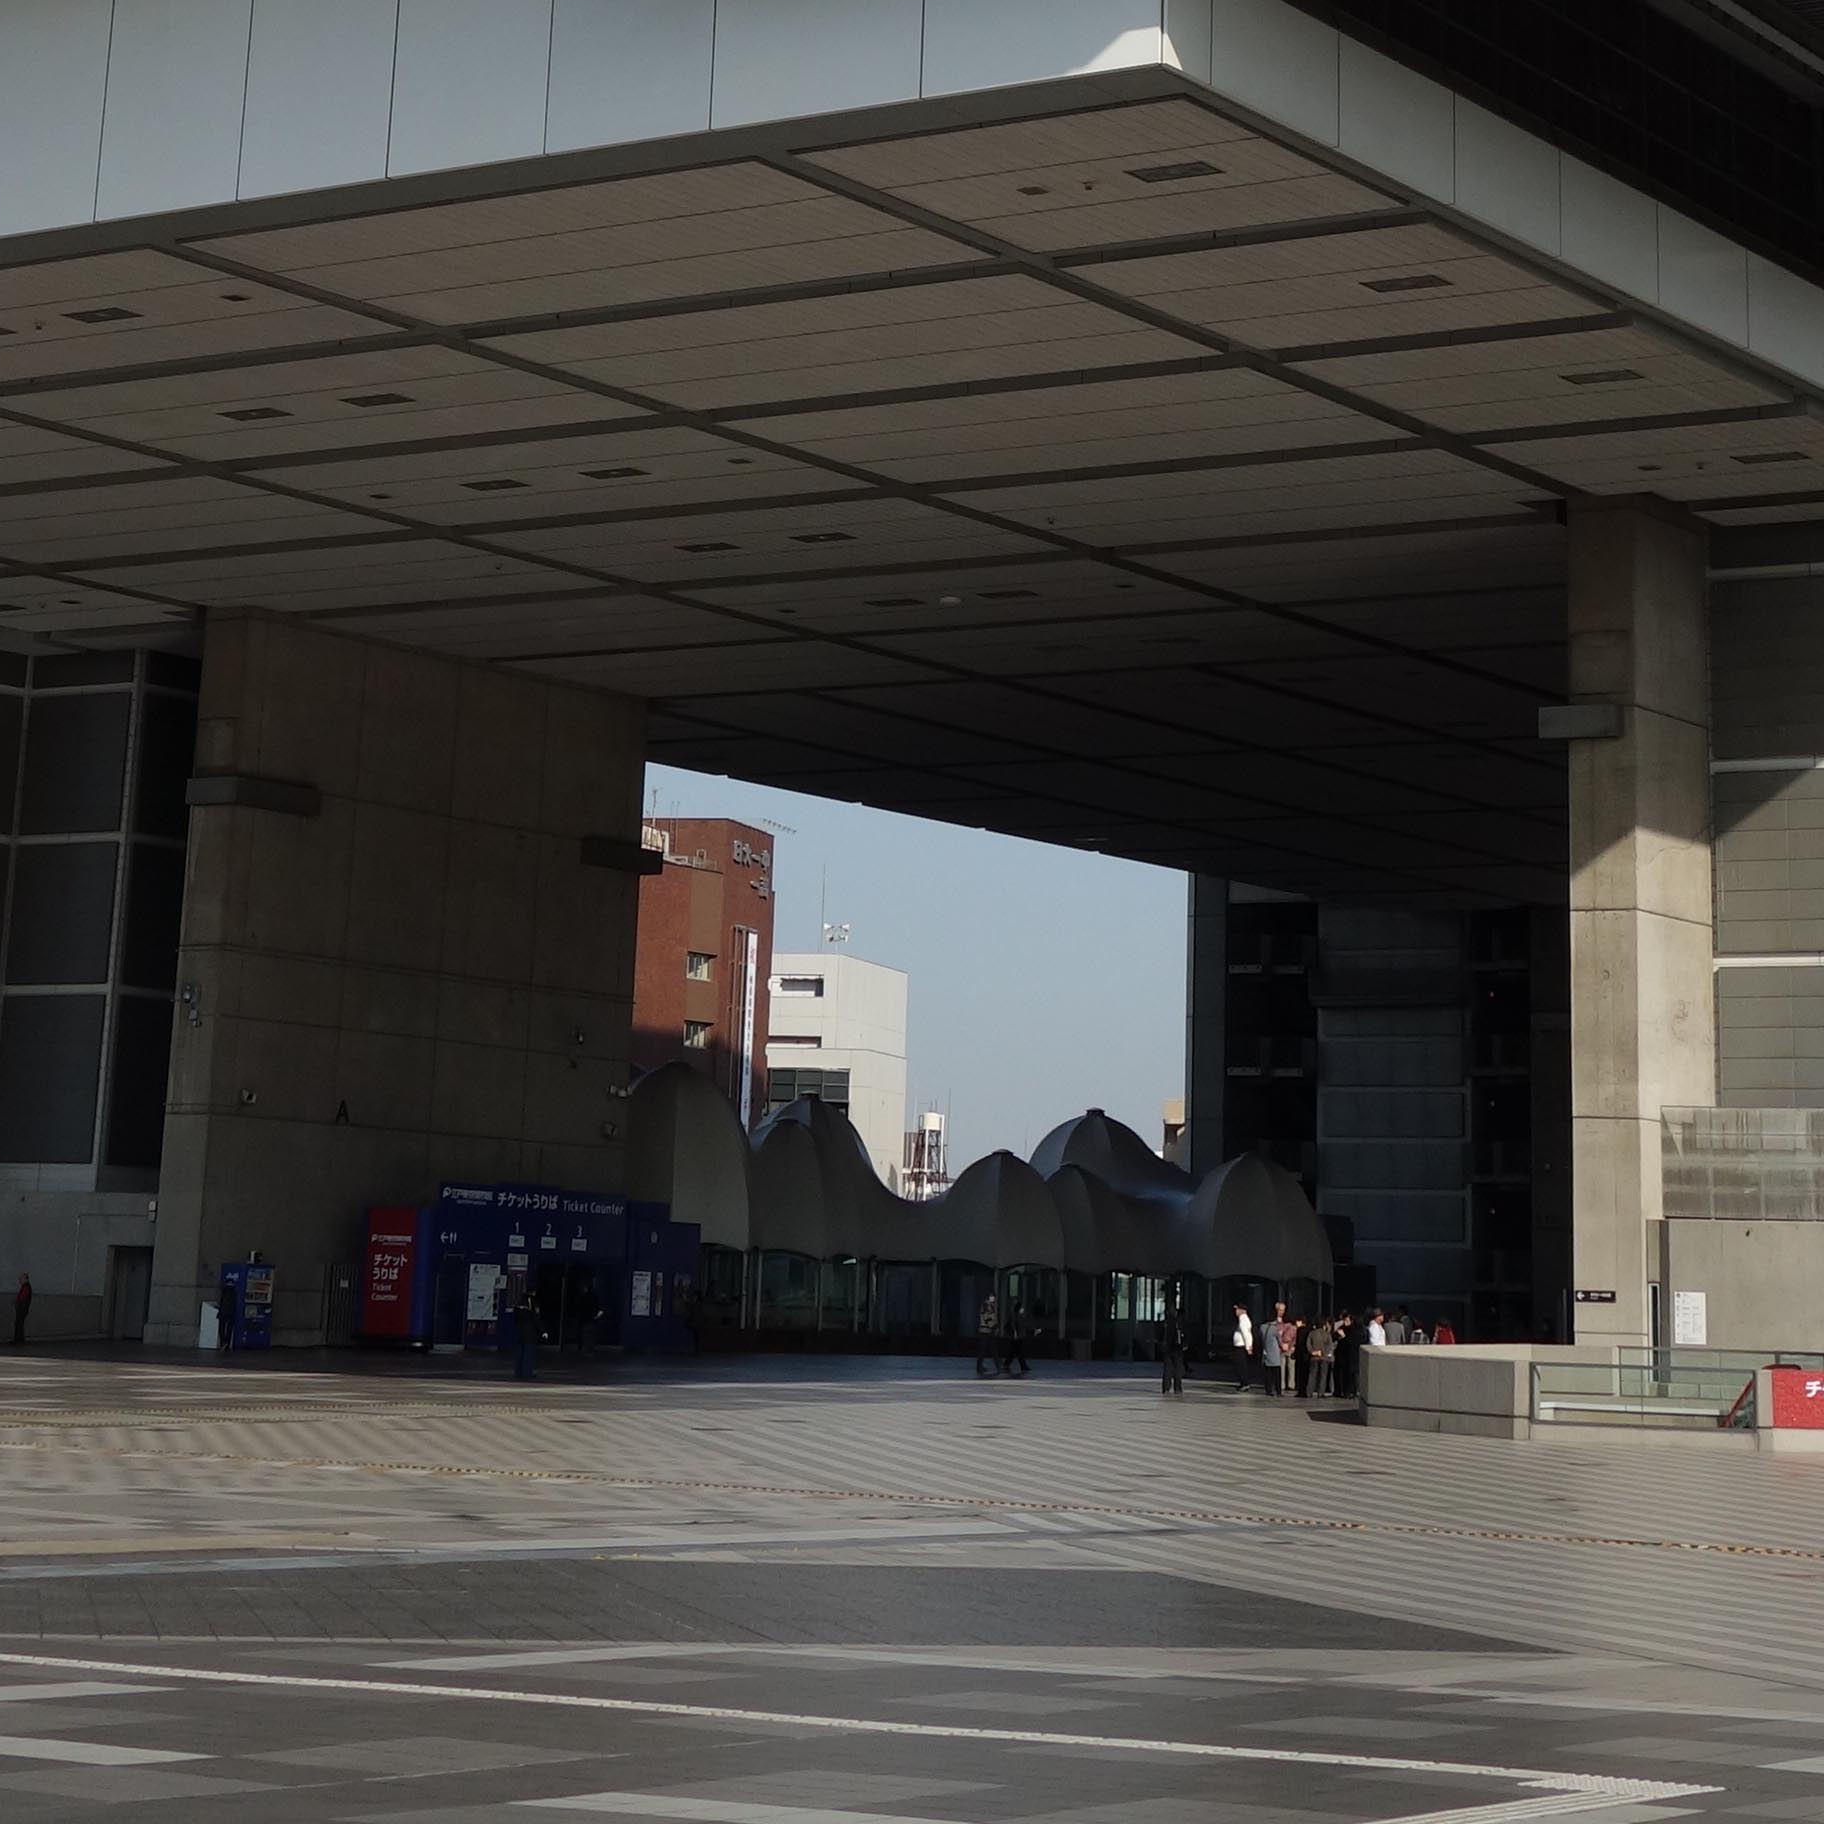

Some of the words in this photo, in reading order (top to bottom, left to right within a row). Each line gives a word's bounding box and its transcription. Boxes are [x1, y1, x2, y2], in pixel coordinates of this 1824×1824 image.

[498, 1191, 559, 1211] チケットうりば
[562, 1199, 588, 1213] Ticket
[590, 1201, 625, 1216] Counter
[514, 1221, 520, 1233] 1
[545, 1223, 552, 1235] 2
[576, 1225, 583, 1237] 3
[373, 1253, 408, 1267] チケット
[372, 1266, 399, 1280] うりば
